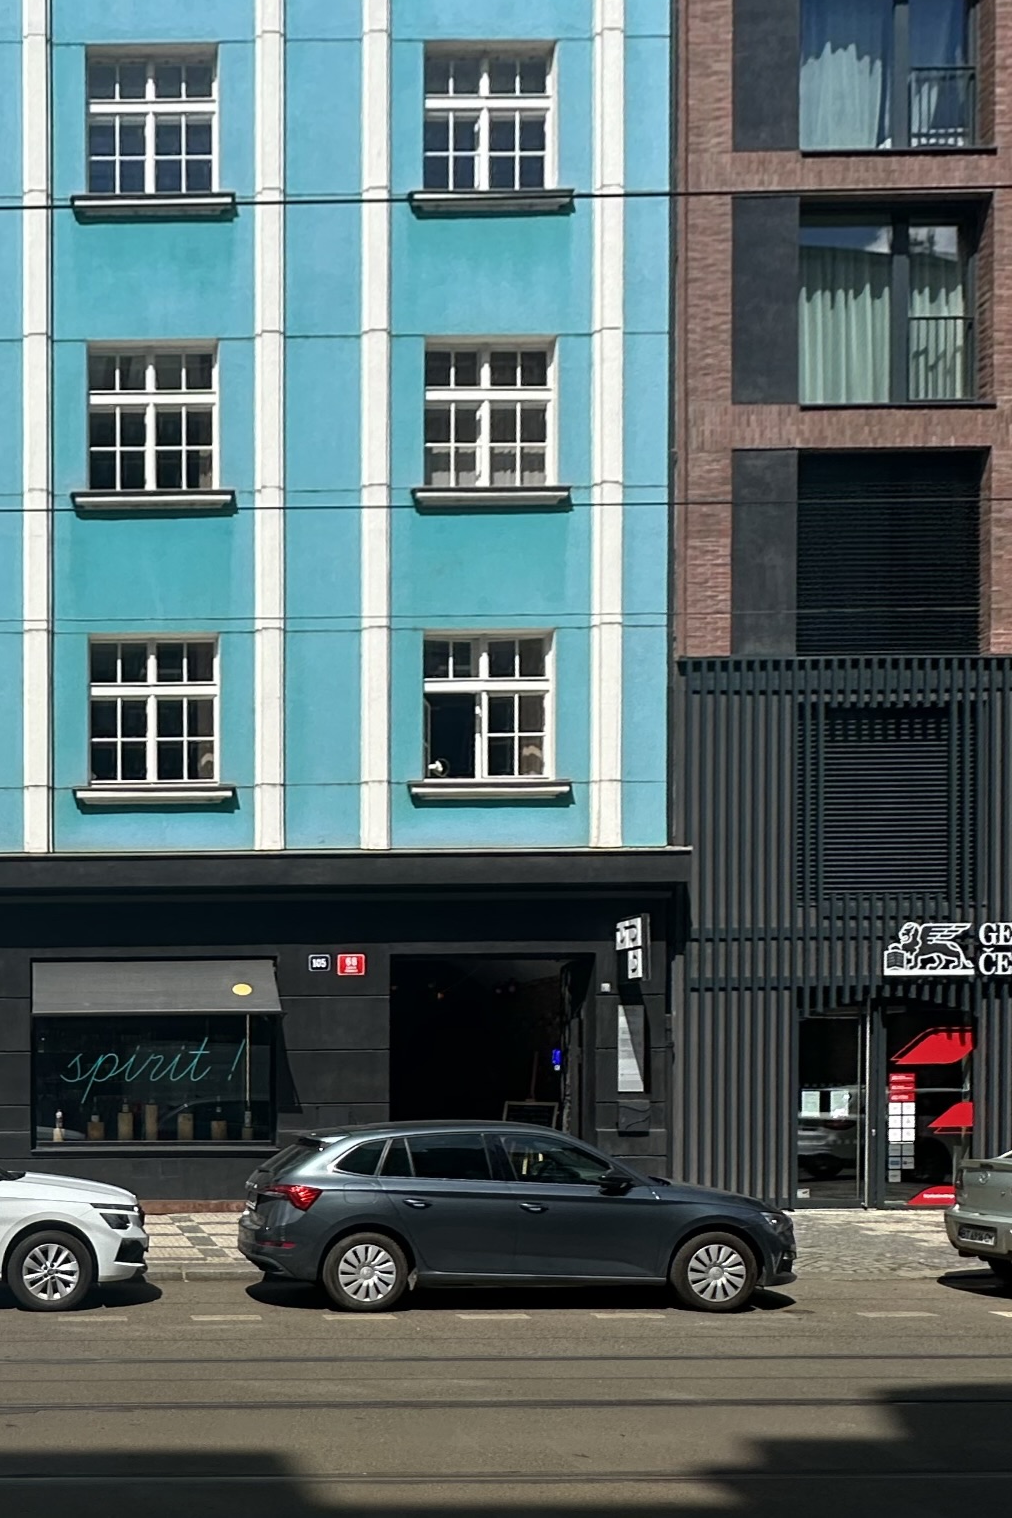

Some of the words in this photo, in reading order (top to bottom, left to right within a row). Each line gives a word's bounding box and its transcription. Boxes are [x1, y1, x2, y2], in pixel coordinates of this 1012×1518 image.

[978, 923, 1012, 945] GE
[312, 958, 327, 968] 105
[978, 947, 1012, 975] ČE
[60, 1037, 211, 1104] spirit
